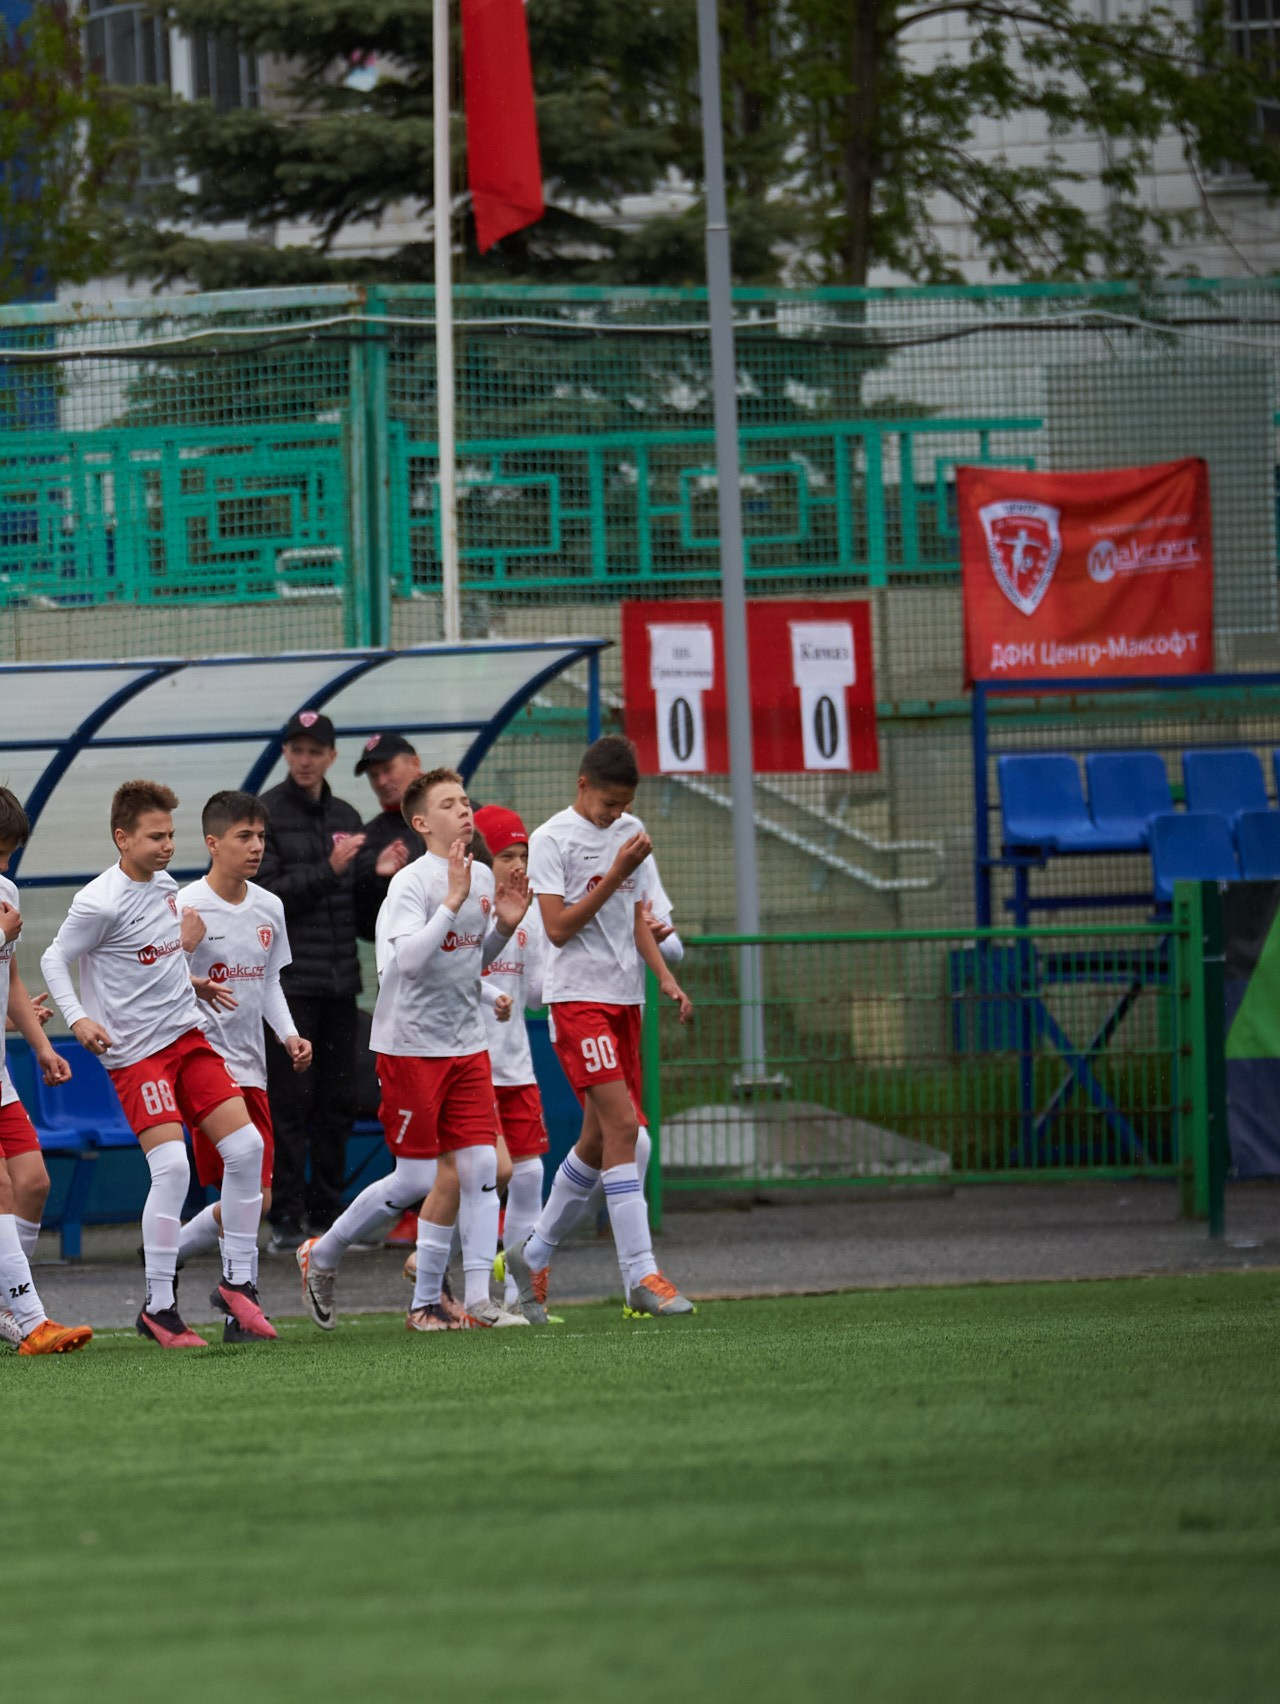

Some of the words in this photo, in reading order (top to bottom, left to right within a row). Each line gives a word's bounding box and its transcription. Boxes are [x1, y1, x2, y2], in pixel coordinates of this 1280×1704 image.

[991, 642, 1036, 671] ДФК
[1040, 628, 1199, 667] Центр-Максофт
[581, 1036, 617, 1073] 90
[141, 1079, 176, 1115] 88
[395, 1109, 413, 1144] 7
